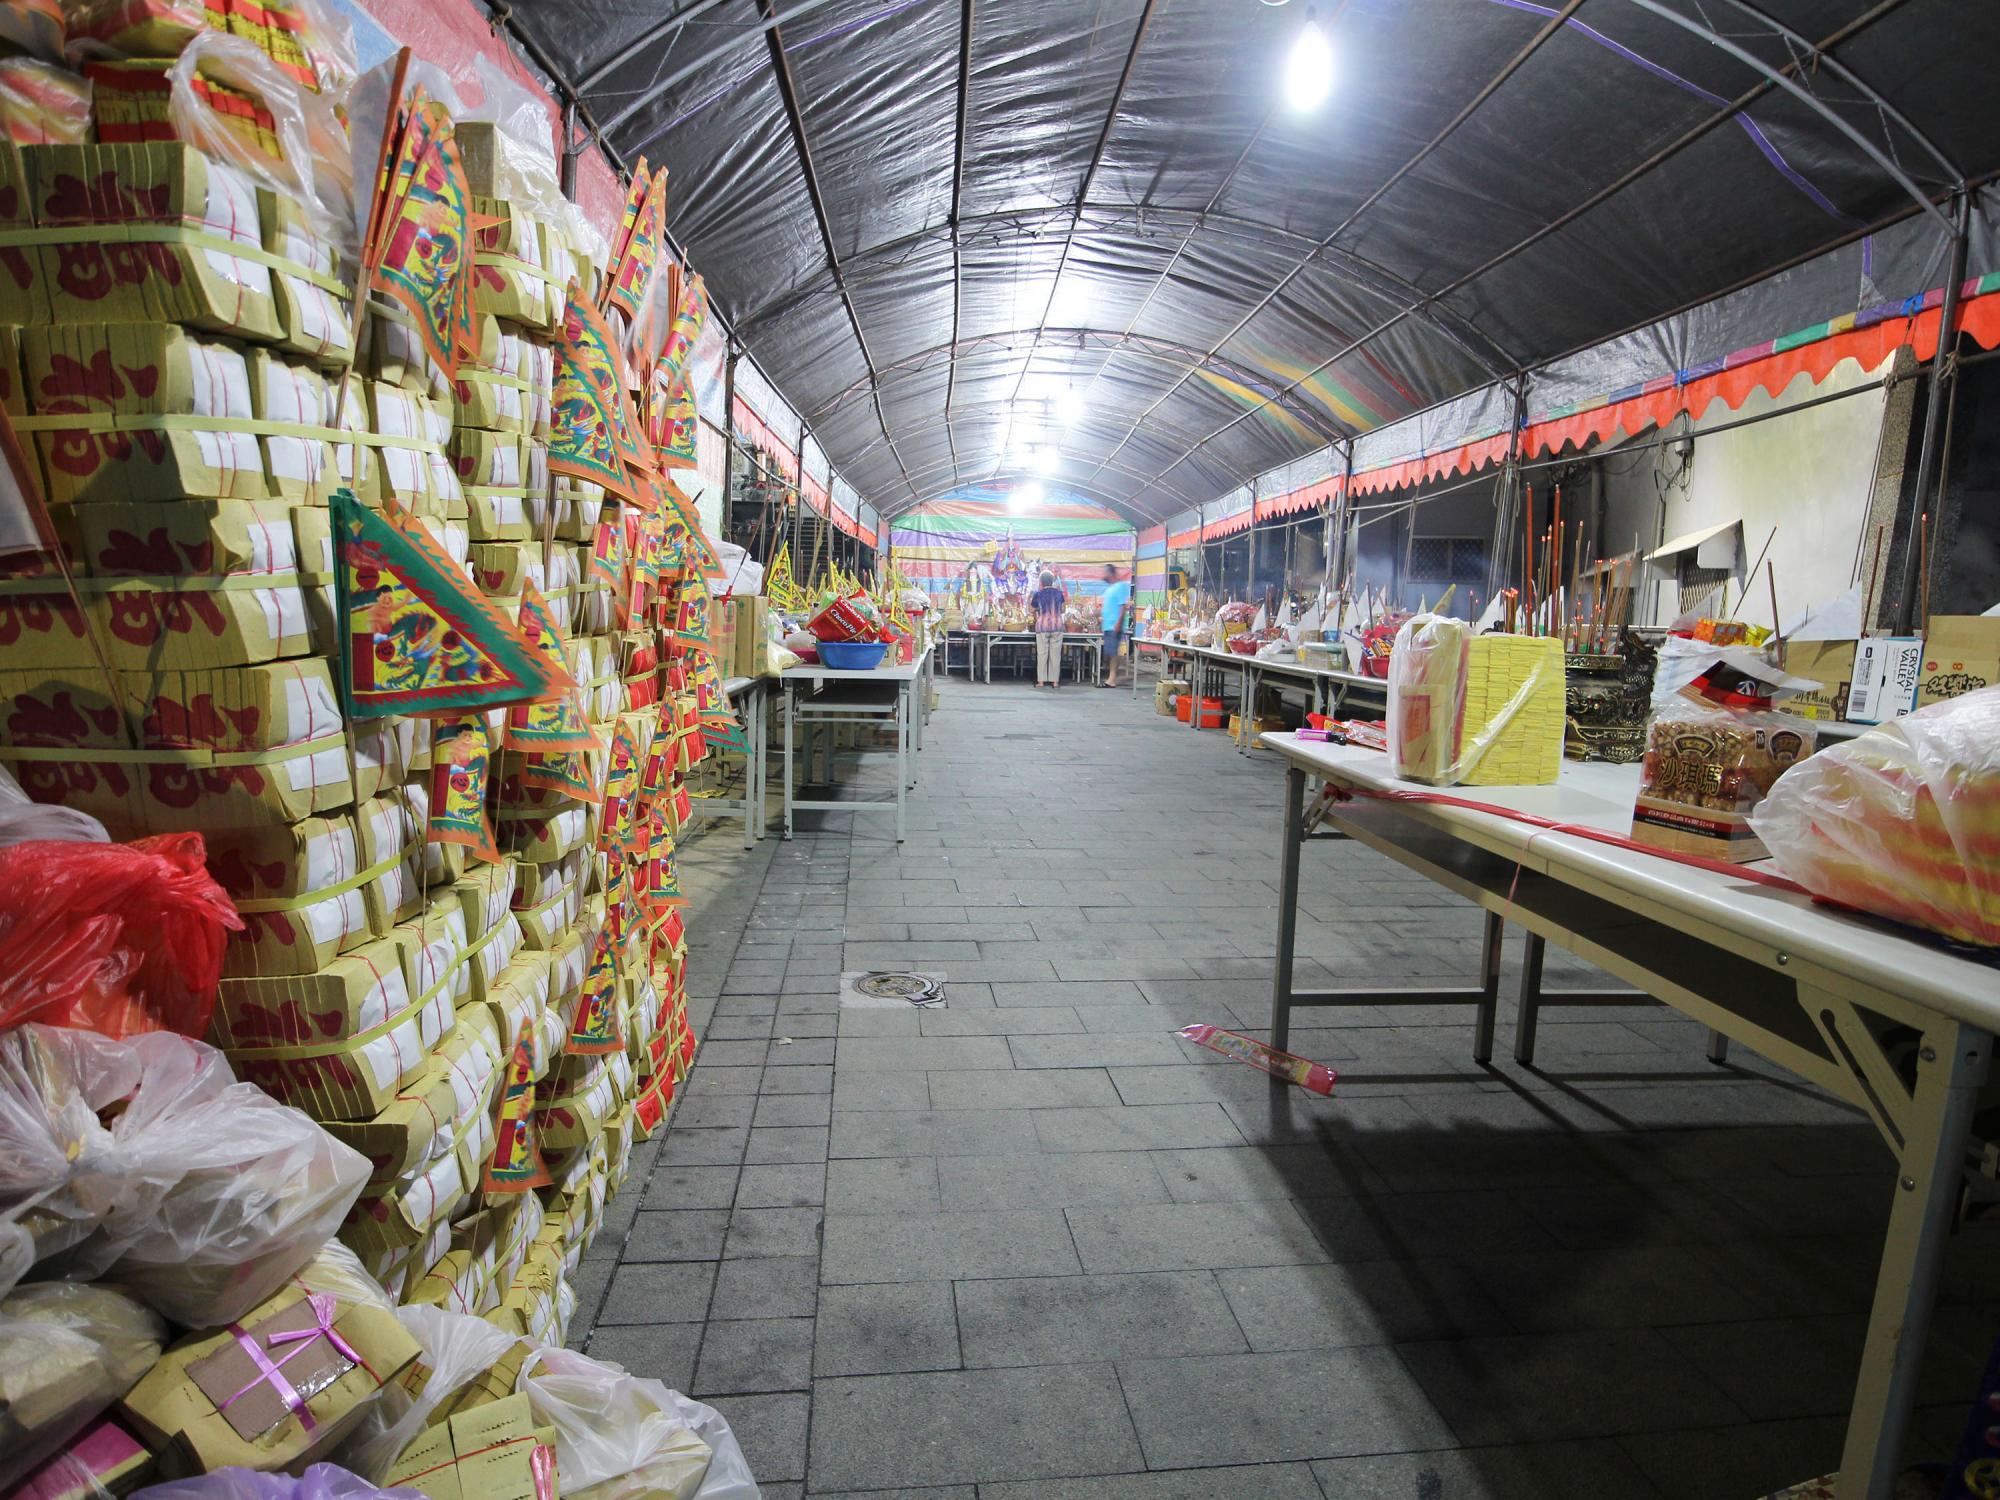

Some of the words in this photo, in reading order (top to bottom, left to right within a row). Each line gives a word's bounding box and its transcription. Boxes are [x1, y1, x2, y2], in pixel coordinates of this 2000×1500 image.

[1897, 648, 1911, 688] VALLEY
[1903, 648, 1919, 693] CRYSTAL
[1659, 758, 1723, 796] 沙琪瑪
